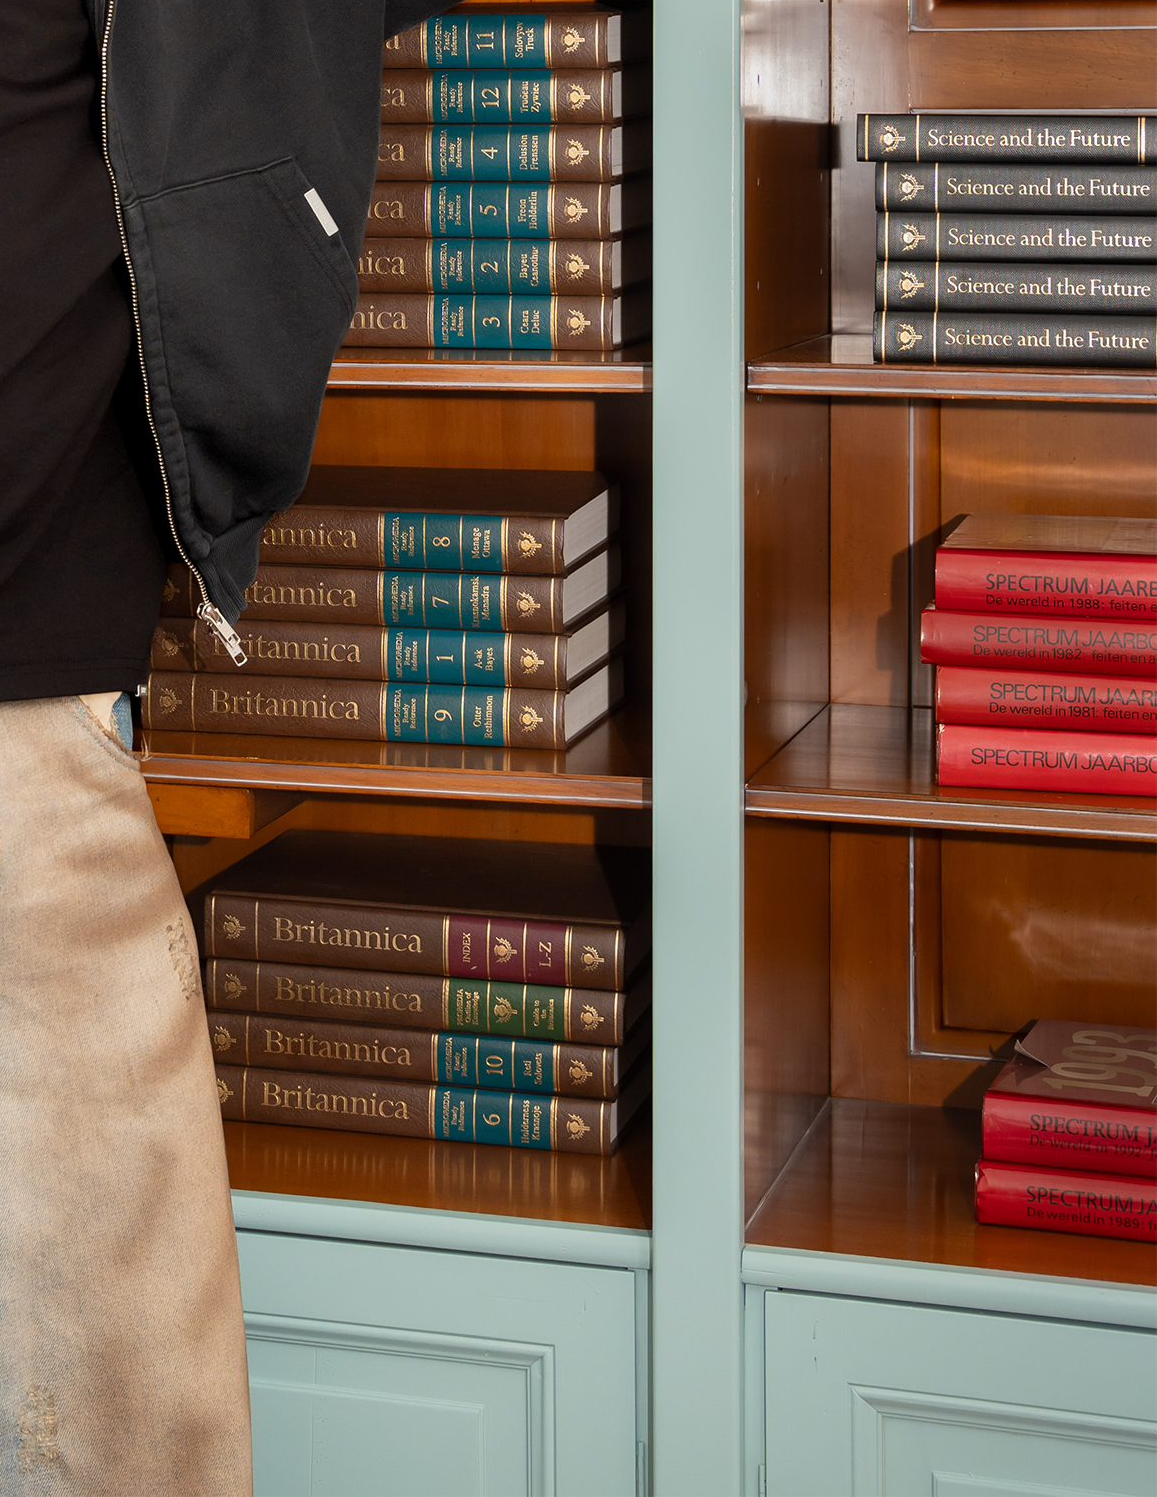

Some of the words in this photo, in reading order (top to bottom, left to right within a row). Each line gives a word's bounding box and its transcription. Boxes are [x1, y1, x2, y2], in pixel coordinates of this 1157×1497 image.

[477, 31, 494, 50] 11
[526, 28, 535, 57] Truck
[481, 87, 500, 108] 12
[928, 129, 995, 147] Science
[1000, 129, 1032, 147] and
[1037, 129, 1065, 147] the
[1070, 130, 1130, 147] Future
[481, 146, 498, 159] 4
[520, 134, 528, 170] Delusion
[530, 135, 538, 170] Frenssen
[947, 178, 1014, 196] Science
[1019, 178, 1051, 196] and
[1057, 178, 1085, 196] the
[1089, 179, 1150, 197] Future
[480, 205, 497, 216] 5
[518, 198, 527, 223] Freon
[529, 191, 538, 229] Holderlin
[481, 262, 499, 273] 2
[519, 254, 529, 278] Bayeu
[483, 316, 500, 328] 3
[521, 310, 529, 334] Ceara
[531, 310, 540, 334] Deluc
[945, 329, 1012, 347] Science
[1017, 329, 1050, 347] and
[1056, 329, 1084, 348] the
[1088, 331, 1149, 349] Future
[433, 536, 451, 547] 8
[986, 573, 1088, 594] SPECTRUM
[432, 596, 449, 608] 7
[986, 595, 1002, 605] De
[1007, 596, 1051, 608] wereld
[1054, 597, 1064, 608] in
[1070, 598, 1104, 609] 1988:
[1109, 600, 1146, 612] feiten
[973, 625, 1078, 647] SPECTRUM
[485, 648, 493, 671] Bayes
[210, 688, 360, 720] Britannica
[990, 683, 1095, 704] SPECTRUM
[434, 709, 452, 721] 9
[473, 706, 482, 727] Otter
[484, 695, 493, 739] Rethimnon
[971, 748, 1077, 770] SPECTRUM
[273, 916, 423, 953] Britannica
[539, 942, 552, 968] L-Z
[275, 977, 423, 1012] Britannica
[264, 1028, 412, 1066] Britannica
[486, 1054, 503, 1076] 10
[261, 1081, 409, 1120] Britannica
[484, 1113, 500, 1126] 6
[522, 1100, 530, 1143] Holderness
[532, 1106, 540, 1140] Krasnoje
[1030, 1114, 1139, 1142] SPECTRUM
[1027, 1186, 1133, 1213] SPECTRUM
[1027, 1207, 1044, 1218] De
[1046, 1211, 1090, 1223] wereld
[1094, 1214, 1104, 1224] in
